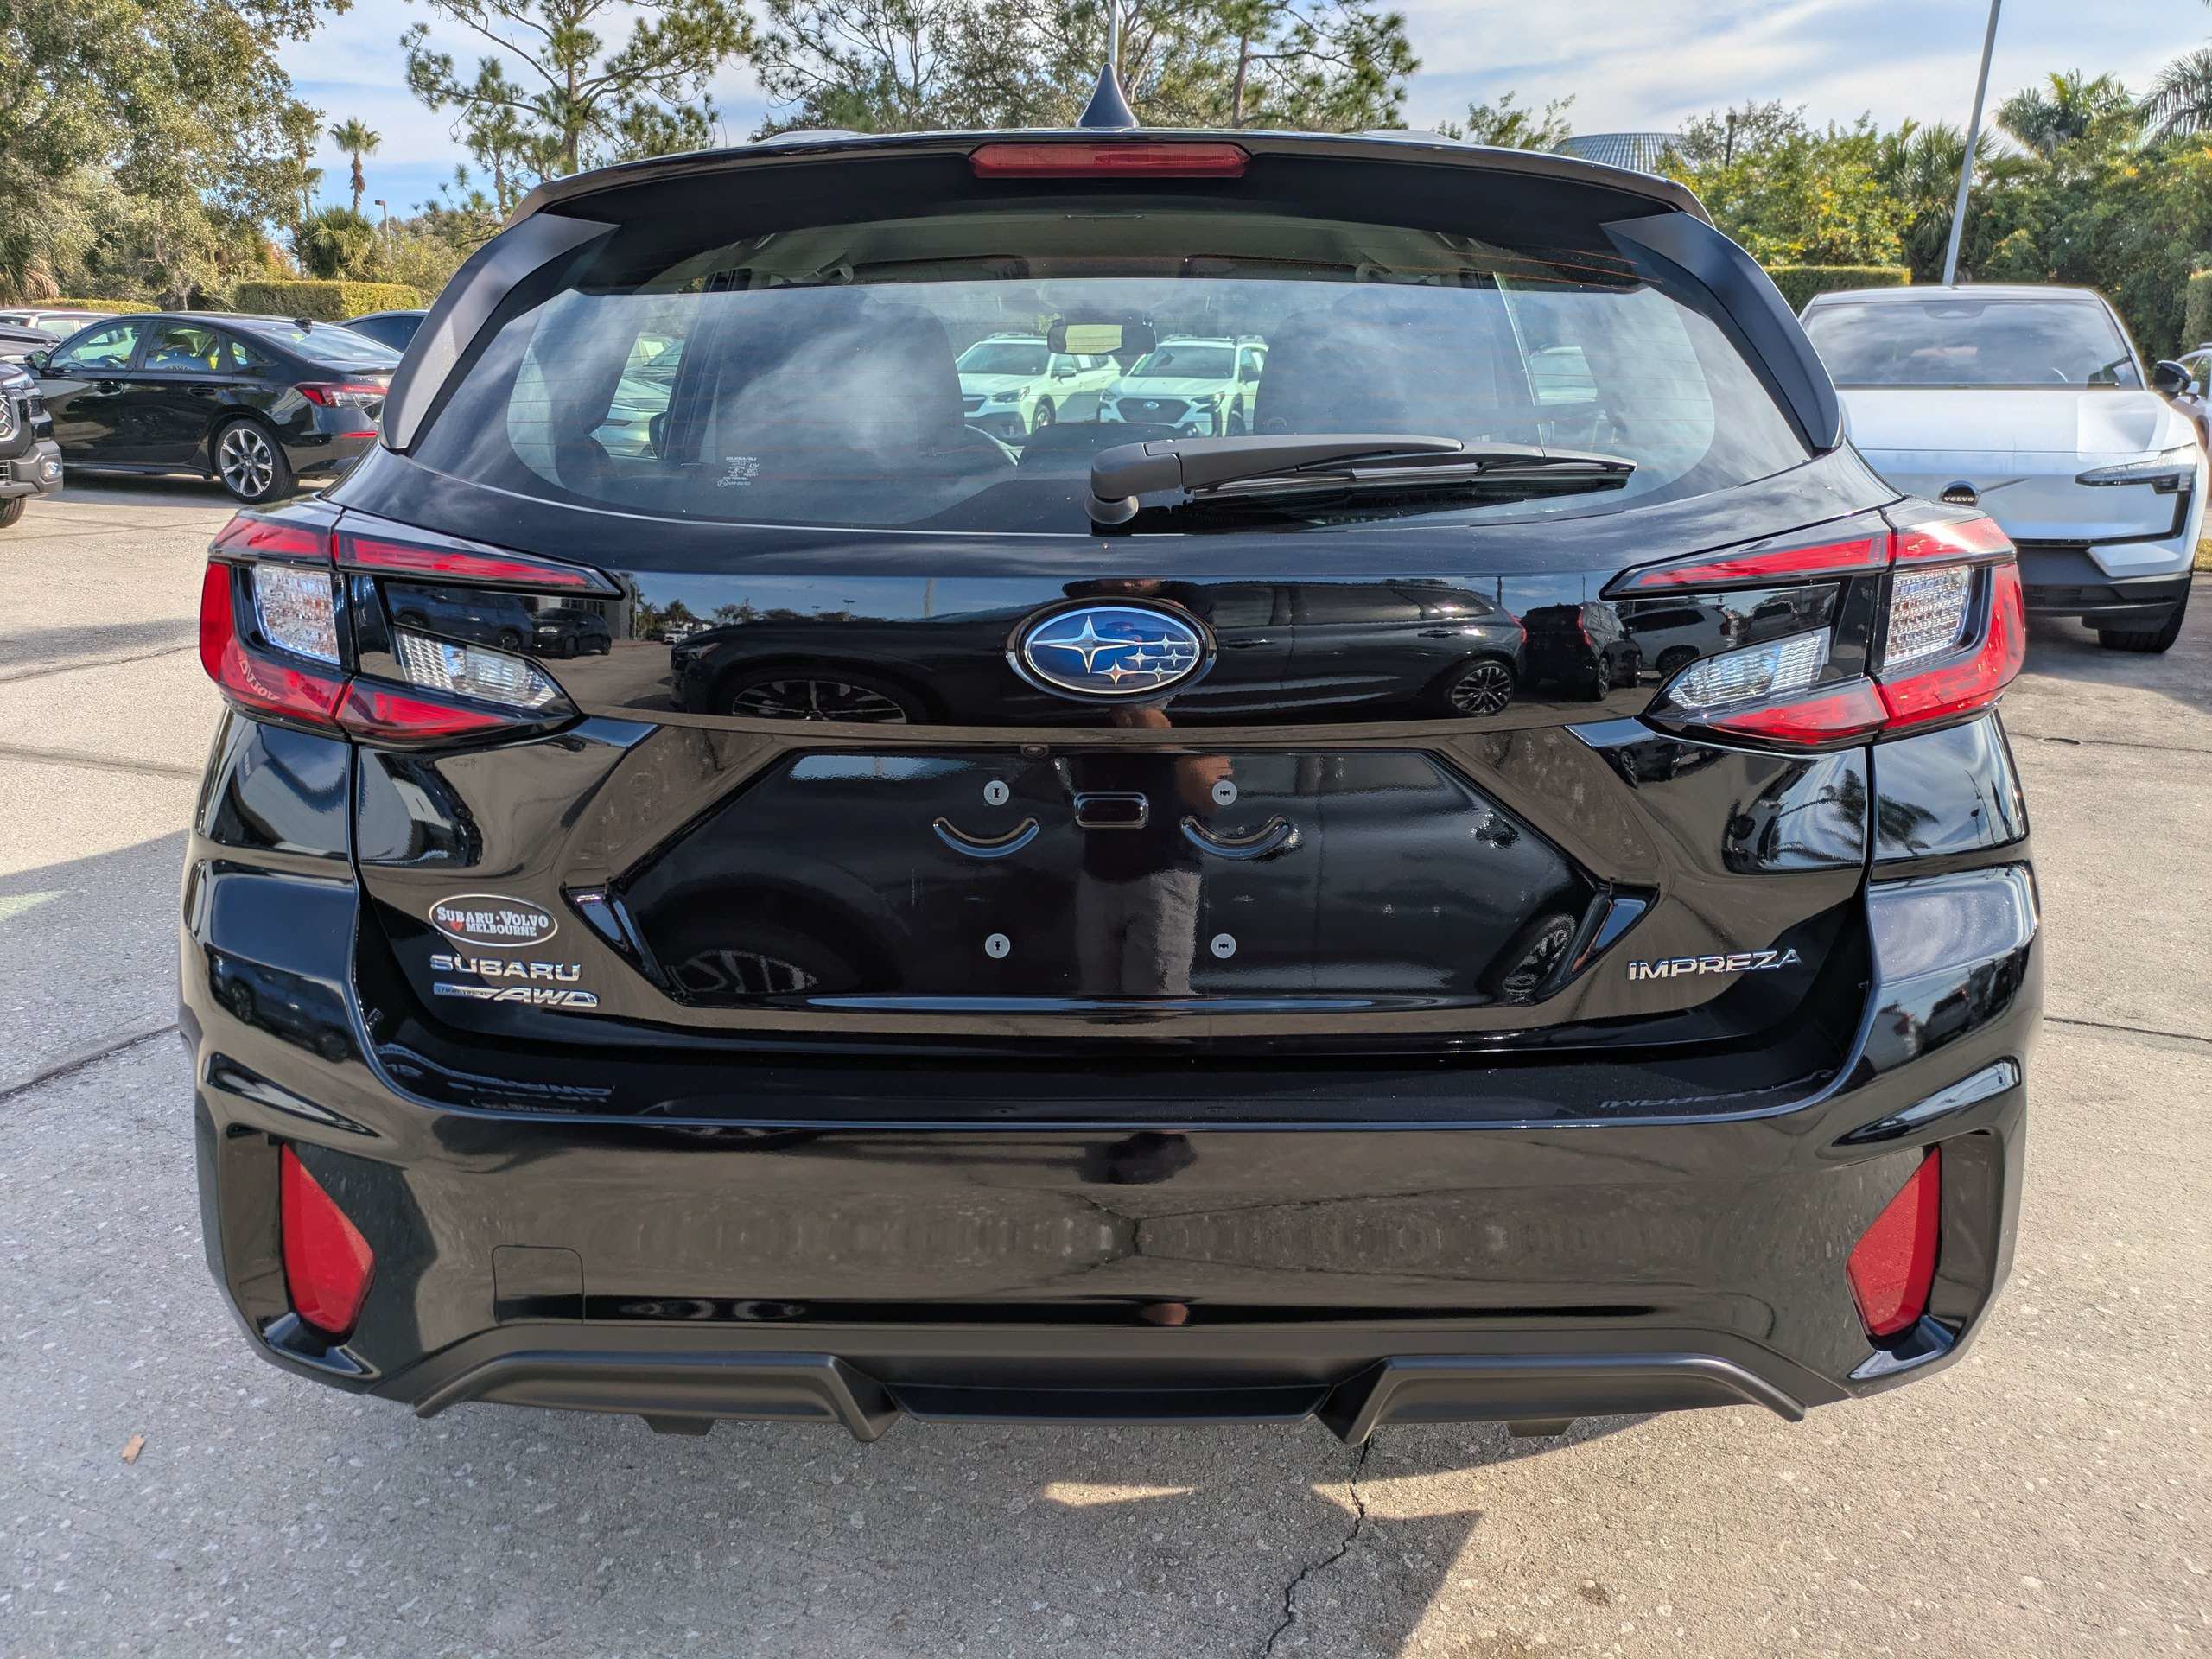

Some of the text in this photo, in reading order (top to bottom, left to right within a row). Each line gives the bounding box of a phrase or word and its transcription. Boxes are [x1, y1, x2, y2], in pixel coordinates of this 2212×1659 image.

[466, 922, 537, 937] MELBOURNE
[430, 954, 582, 982] SUBARU
[1627, 947, 1804, 981] IMPREZA
[493, 987, 598, 1007] AWD
